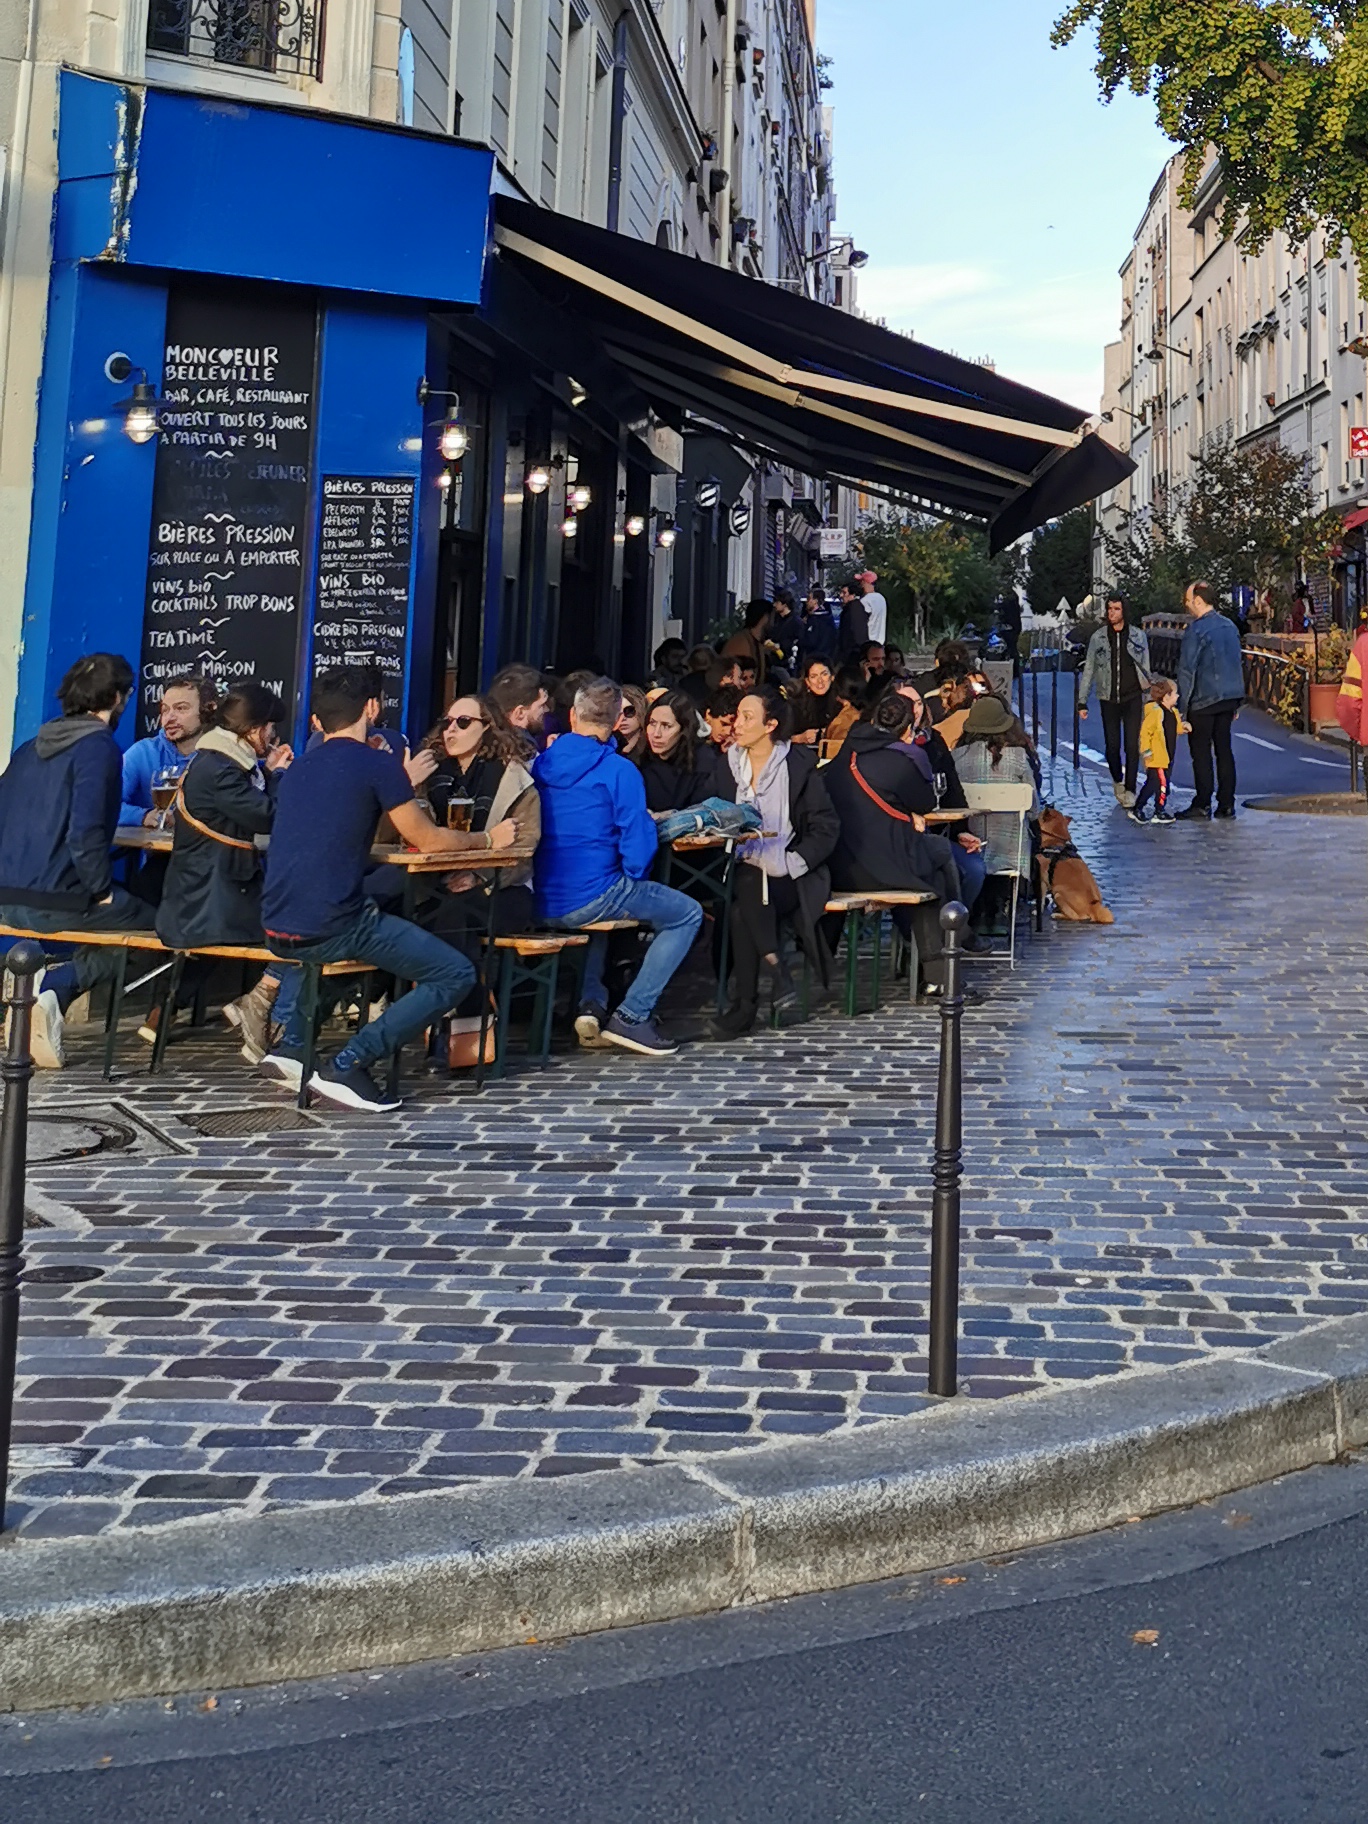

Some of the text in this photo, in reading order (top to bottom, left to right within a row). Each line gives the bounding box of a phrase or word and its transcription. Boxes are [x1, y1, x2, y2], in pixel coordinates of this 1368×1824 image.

[236, 388, 309, 404] RESTAURANT
[161, 412, 308, 430] OUVERT TOUS LES JOURS
[173, 431, 225, 446] PARTIR
[229, 434, 247, 447] DE
[254, 433, 277, 450] 9H
[158, 521, 295, 545] BIÈRES PRESSION
[150, 552, 171, 566] SUR
[173, 552, 202, 565] PLACE
[240, 549, 300, 566] EMPORTER
[151, 594, 295, 613] COCKTAILS TROP BONS
[201, 659, 255, 677] MAISON
